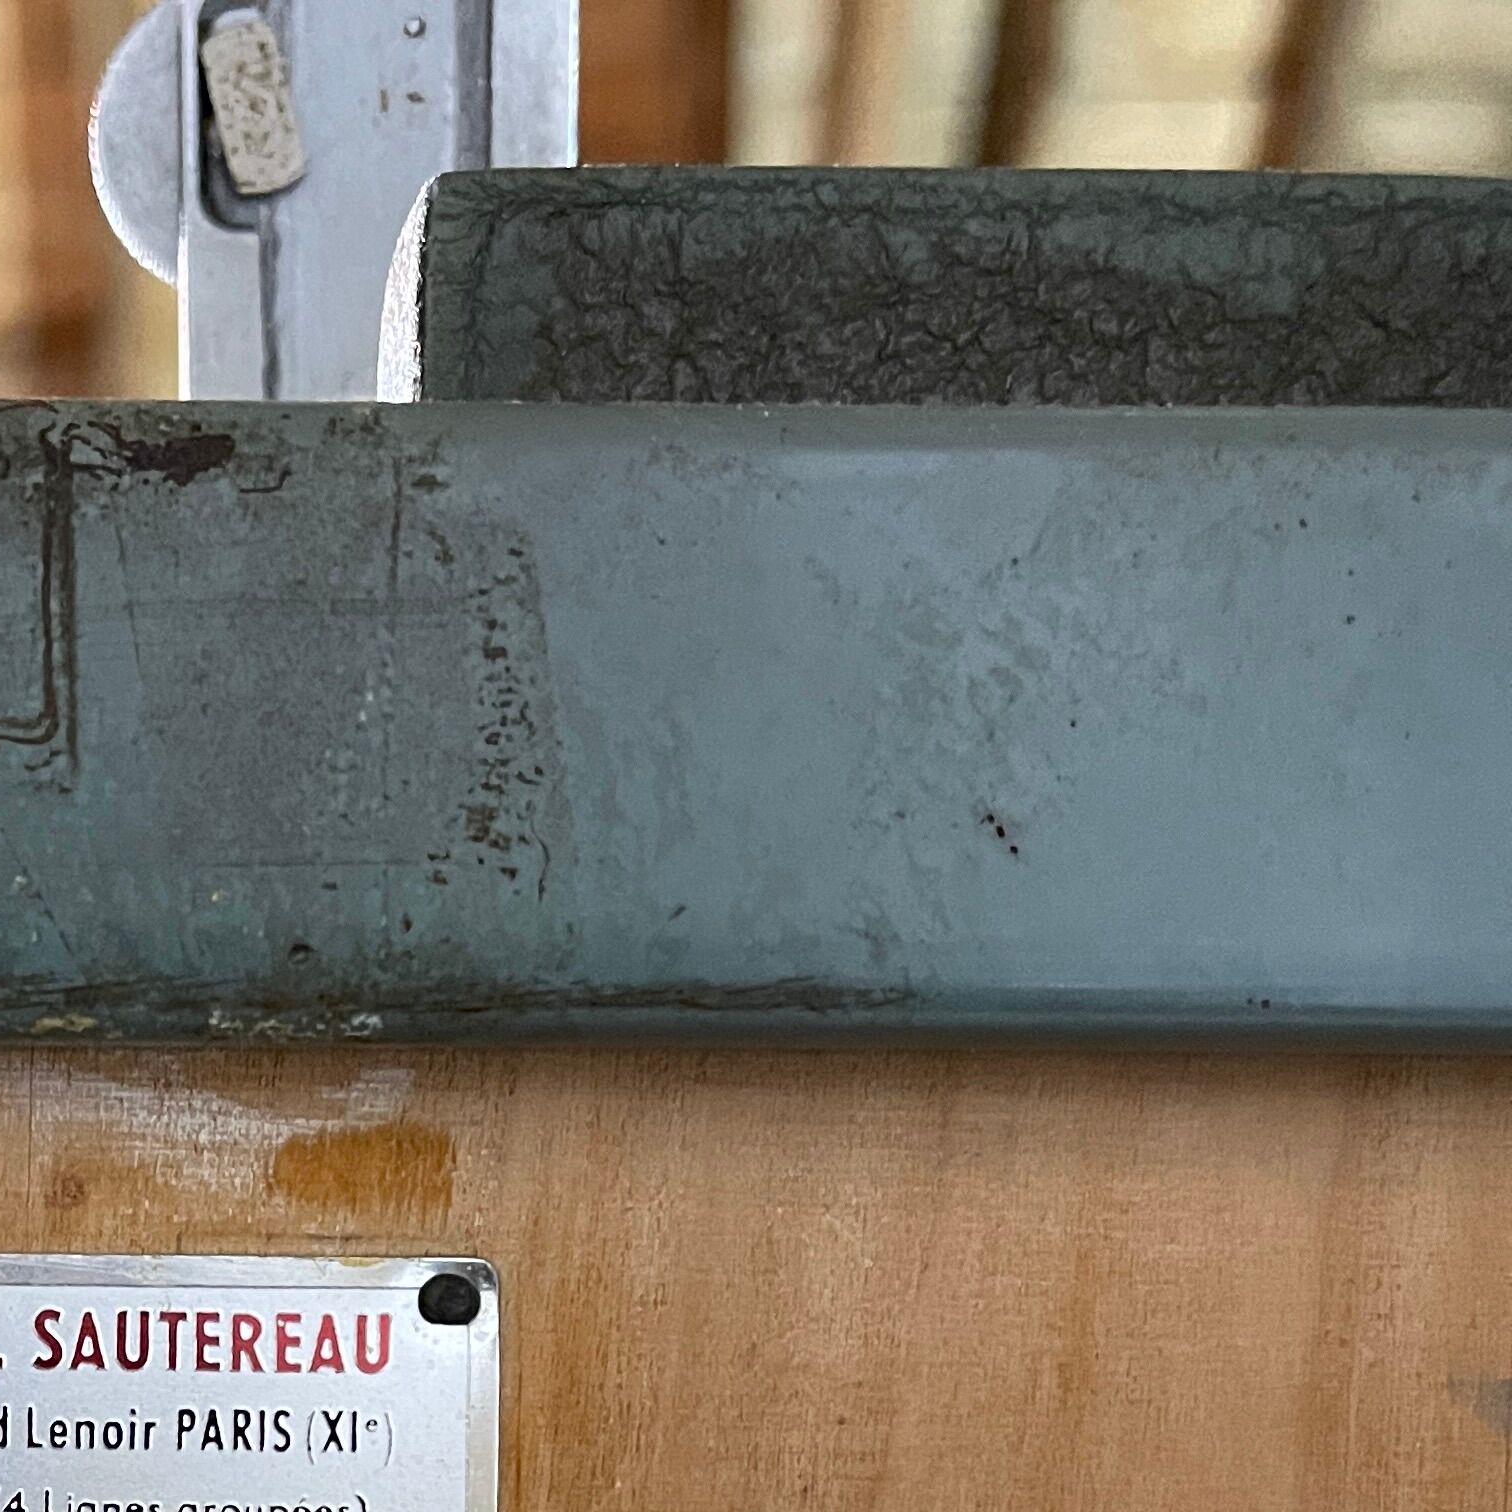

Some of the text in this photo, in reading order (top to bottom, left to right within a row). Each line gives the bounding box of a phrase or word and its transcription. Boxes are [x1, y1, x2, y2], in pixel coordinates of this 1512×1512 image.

[32, 1308, 393, 1375] SAUTEREAU
[27, 1406, 156, 1450] Lenoir
[176, 1408, 291, 1452] PARIS
